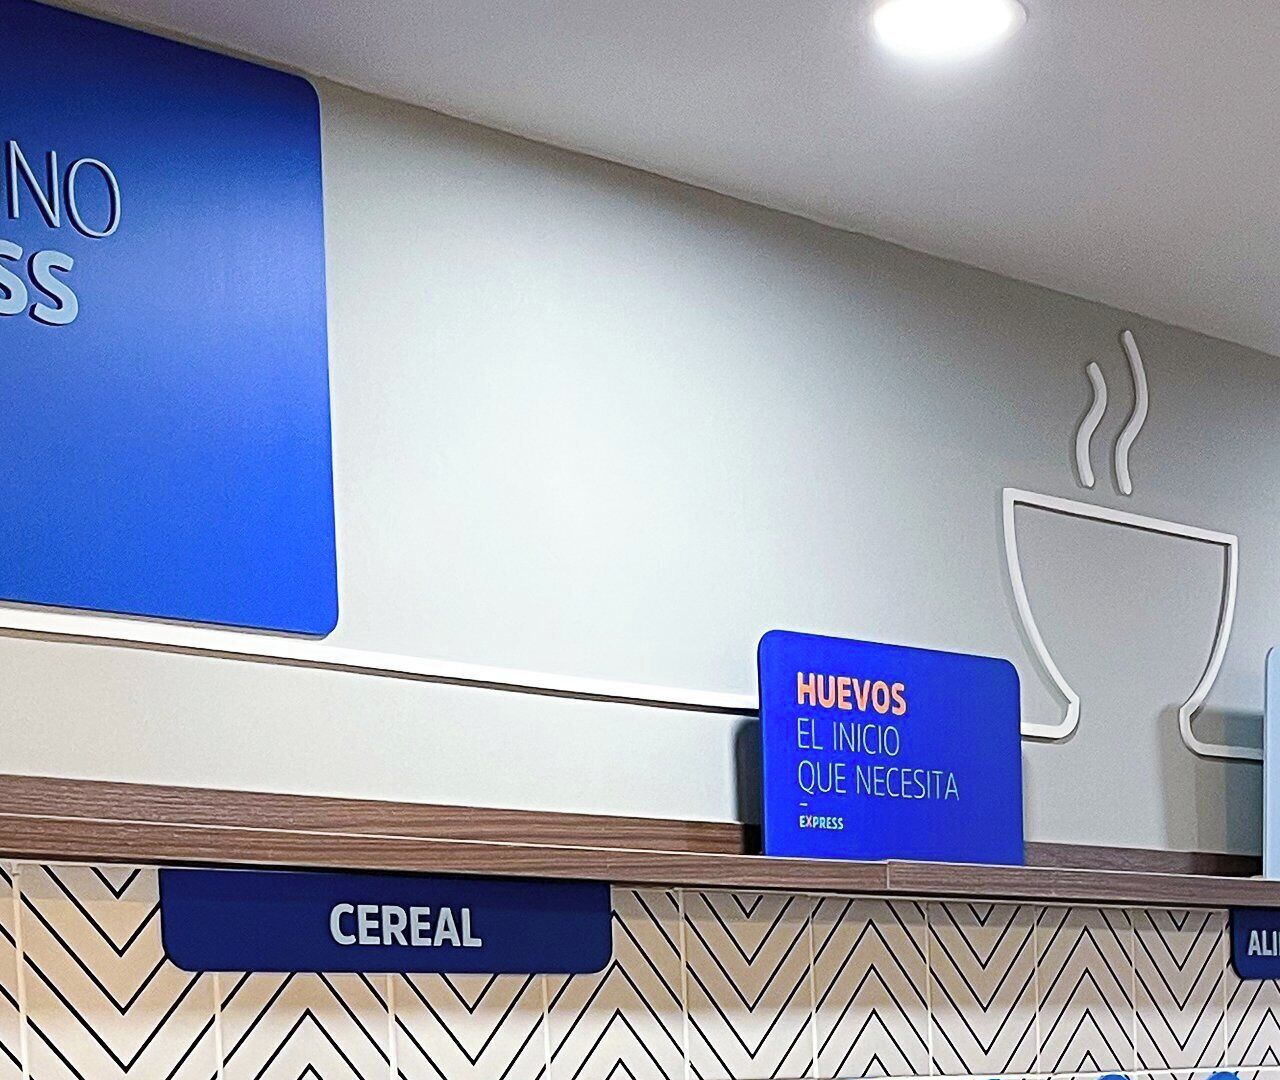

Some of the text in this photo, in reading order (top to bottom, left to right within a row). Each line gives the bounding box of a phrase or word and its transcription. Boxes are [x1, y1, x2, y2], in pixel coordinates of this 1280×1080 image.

[797, 671, 907, 716] HUEVOS
[797, 718, 900, 756] EL INICIO
[798, 759, 960, 801] QUE NECESITA
[799, 814, 844, 830] EXPRESS
[329, 902, 483, 948] CEREAL
